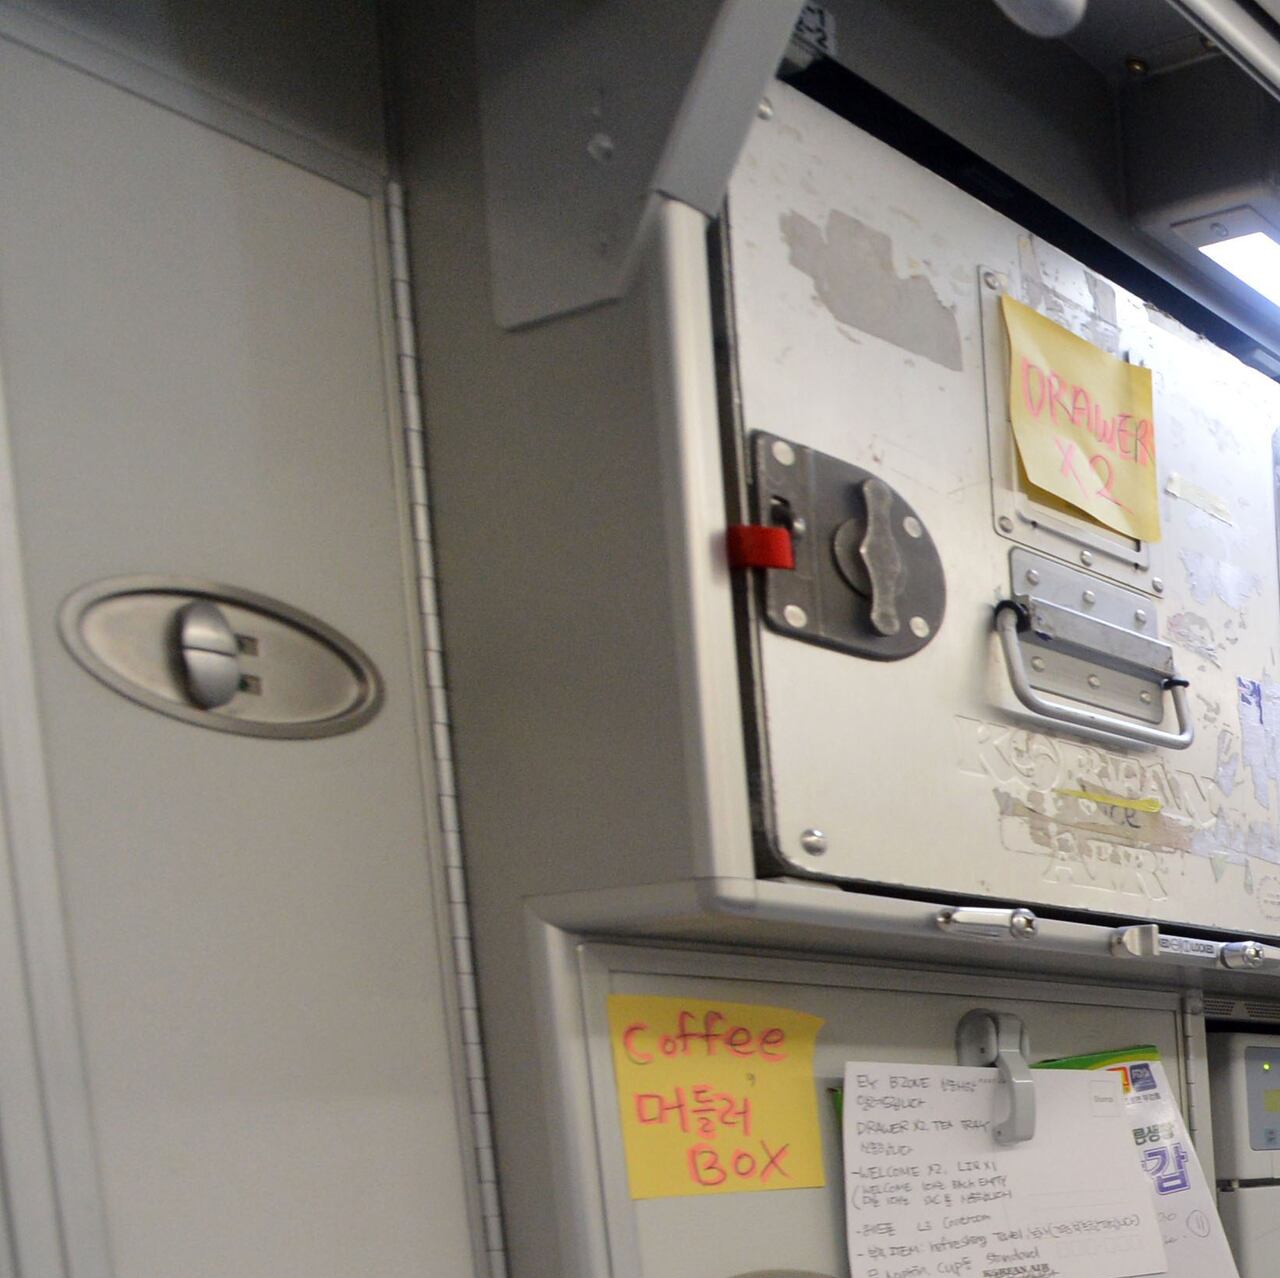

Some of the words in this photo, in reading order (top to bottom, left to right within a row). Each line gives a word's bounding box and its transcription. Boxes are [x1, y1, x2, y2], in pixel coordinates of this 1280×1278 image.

[1020, 355, 1158, 468] DRAWER
[623, 1010, 788, 1065] Coffee
[632, 1083, 753, 1138] 머들러
[687, 1140, 792, 1186] BOX
[1143, 1142, 1191, 1195] 갑
